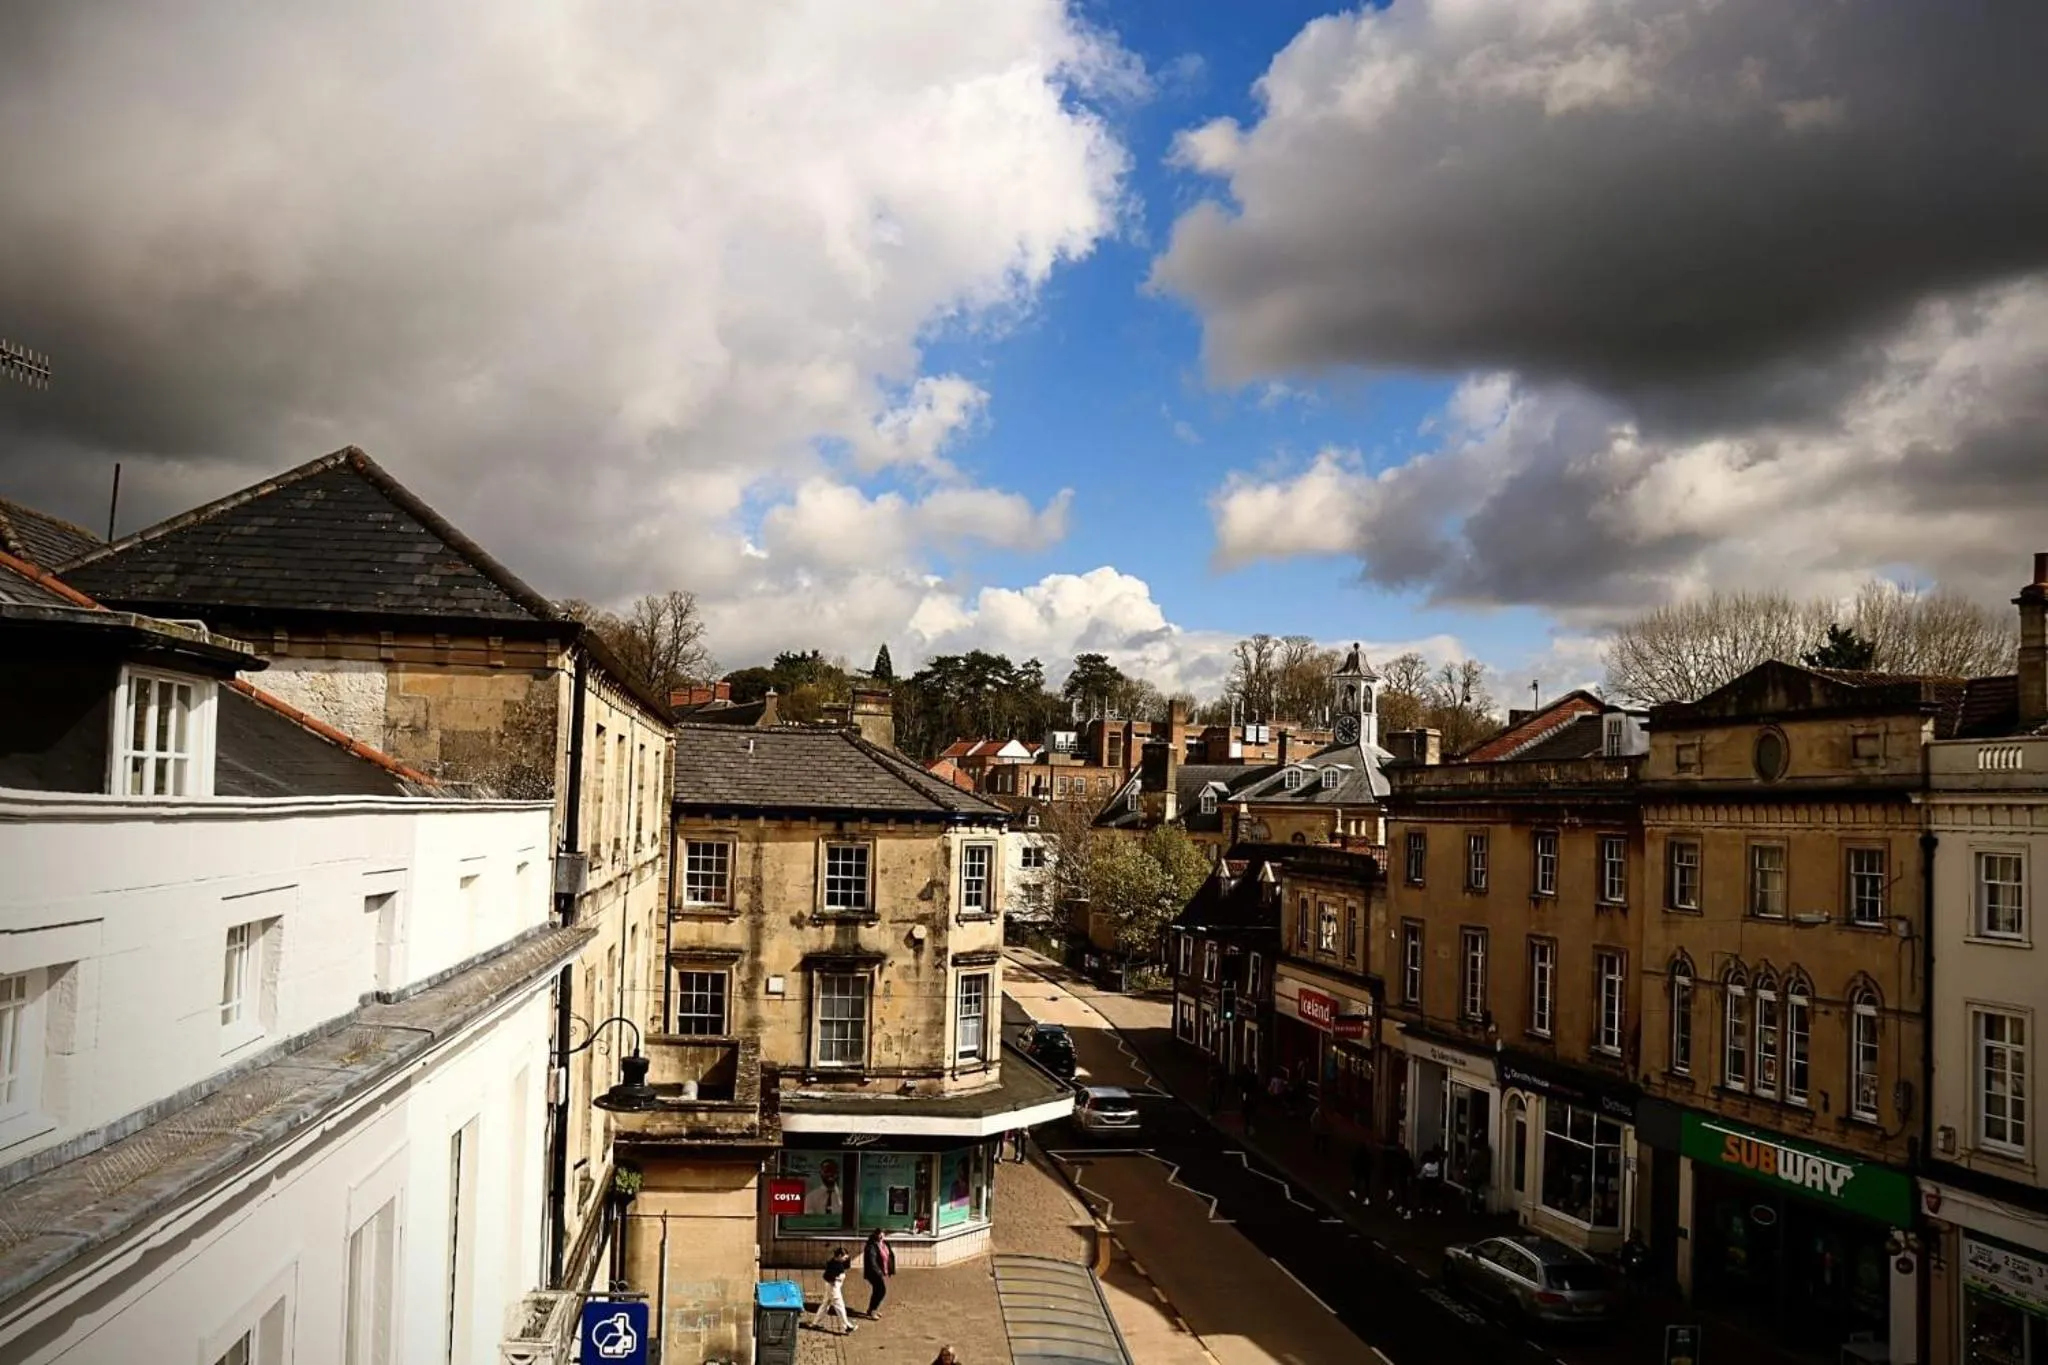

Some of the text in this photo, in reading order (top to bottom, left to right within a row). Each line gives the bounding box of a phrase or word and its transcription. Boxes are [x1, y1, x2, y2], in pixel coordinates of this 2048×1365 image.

[1300, 994, 1330, 1022] Iceland
[1720, 1135, 1855, 1197] SUBWAY
[774, 1193, 801, 1202] COSTA
